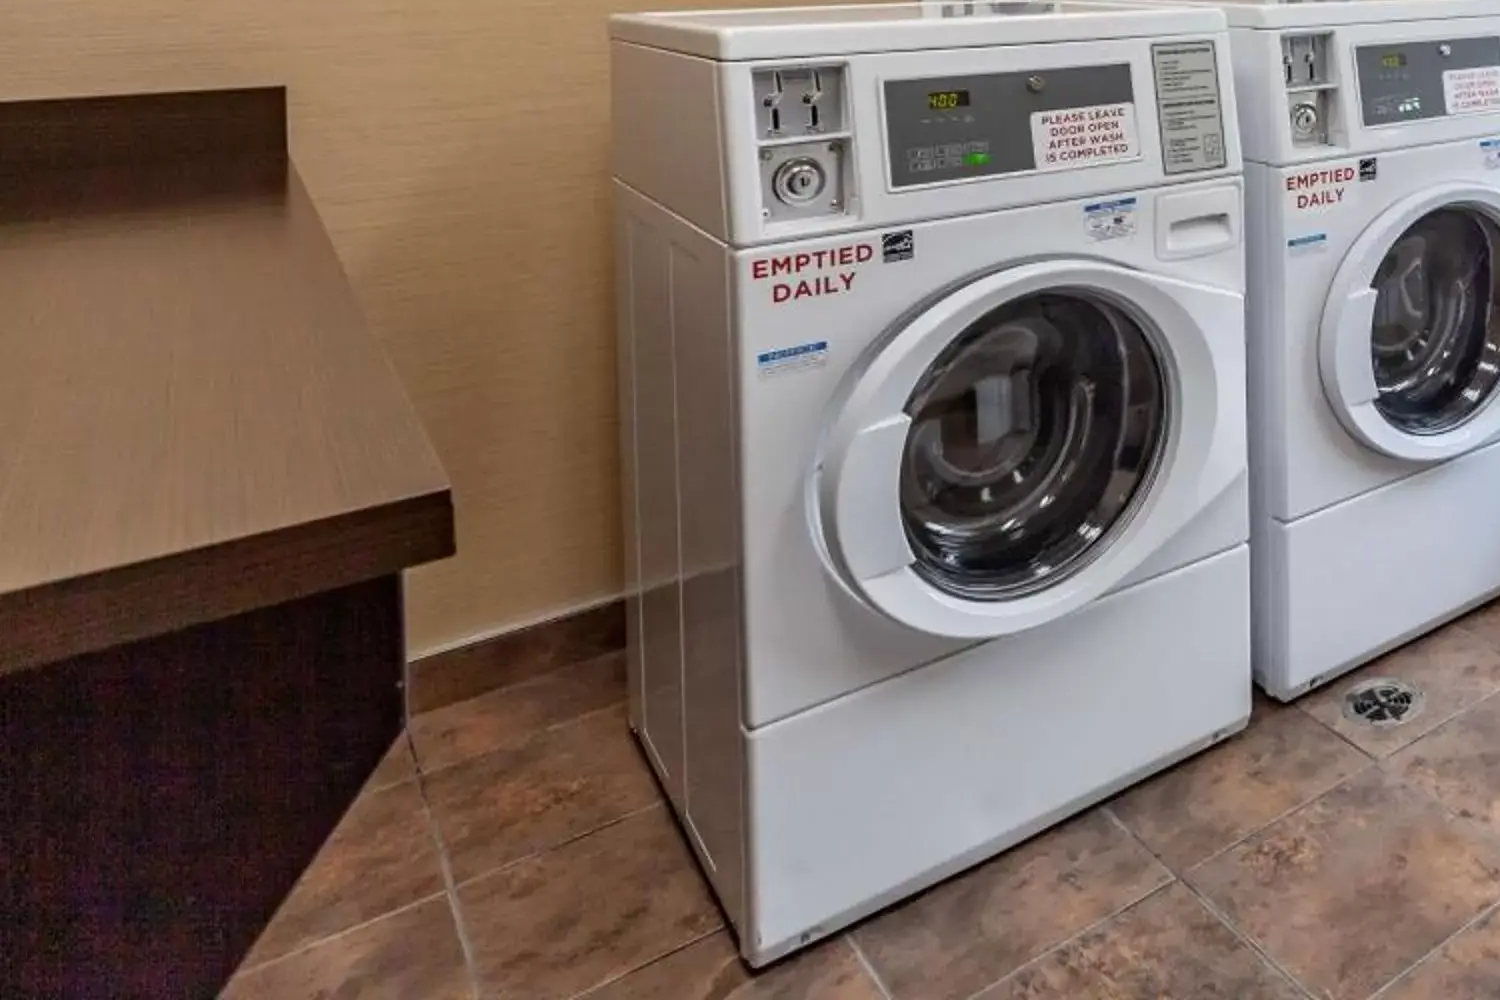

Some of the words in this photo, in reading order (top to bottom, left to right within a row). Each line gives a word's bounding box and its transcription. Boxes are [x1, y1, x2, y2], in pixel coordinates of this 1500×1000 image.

[1041, 111, 1085, 125] PLEASE
[1088, 107, 1125, 121] LEAVE
[1050, 124, 1085, 137] DOOR
[1088, 120, 1119, 133] OPEN
[1049, 136, 1086, 149] AFTER
[1089, 132, 1123, 145] WASH
[1046, 152, 1057, 162] IS
[1059, 143, 1129, 161] COMPLETED
[1287, 168, 1354, 191] EMPTIED
[1297, 188, 1344, 209] DAILY
[752, 244, 873, 279] EMPTIED
[772, 272, 857, 303] DAILY
